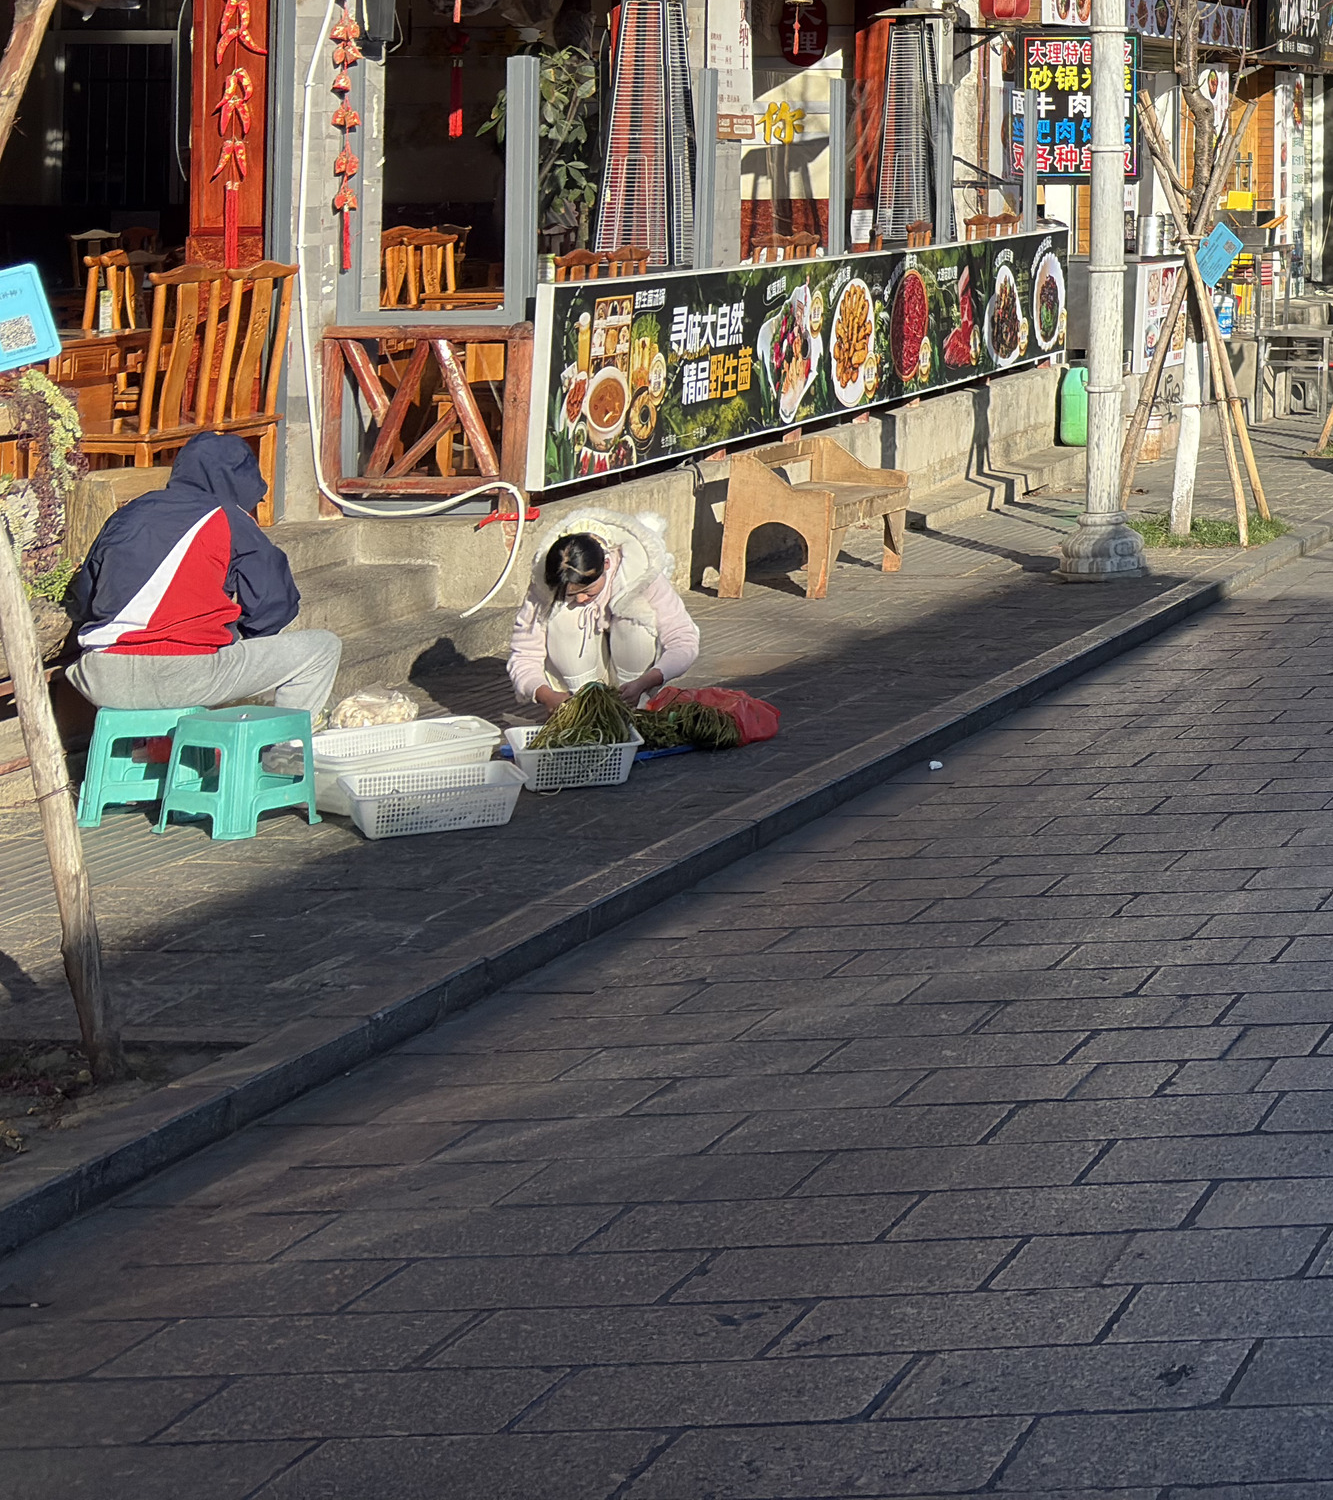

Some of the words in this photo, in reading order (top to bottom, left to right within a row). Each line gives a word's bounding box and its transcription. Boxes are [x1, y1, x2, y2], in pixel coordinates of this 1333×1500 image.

[1029, 41, 1131, 65] 大理特色
[634, 288, 666, 310] 野生菌汤锅
[670, 300, 744, 356] 寻味大自然
[682, 346, 752, 405] 精品野生菌
